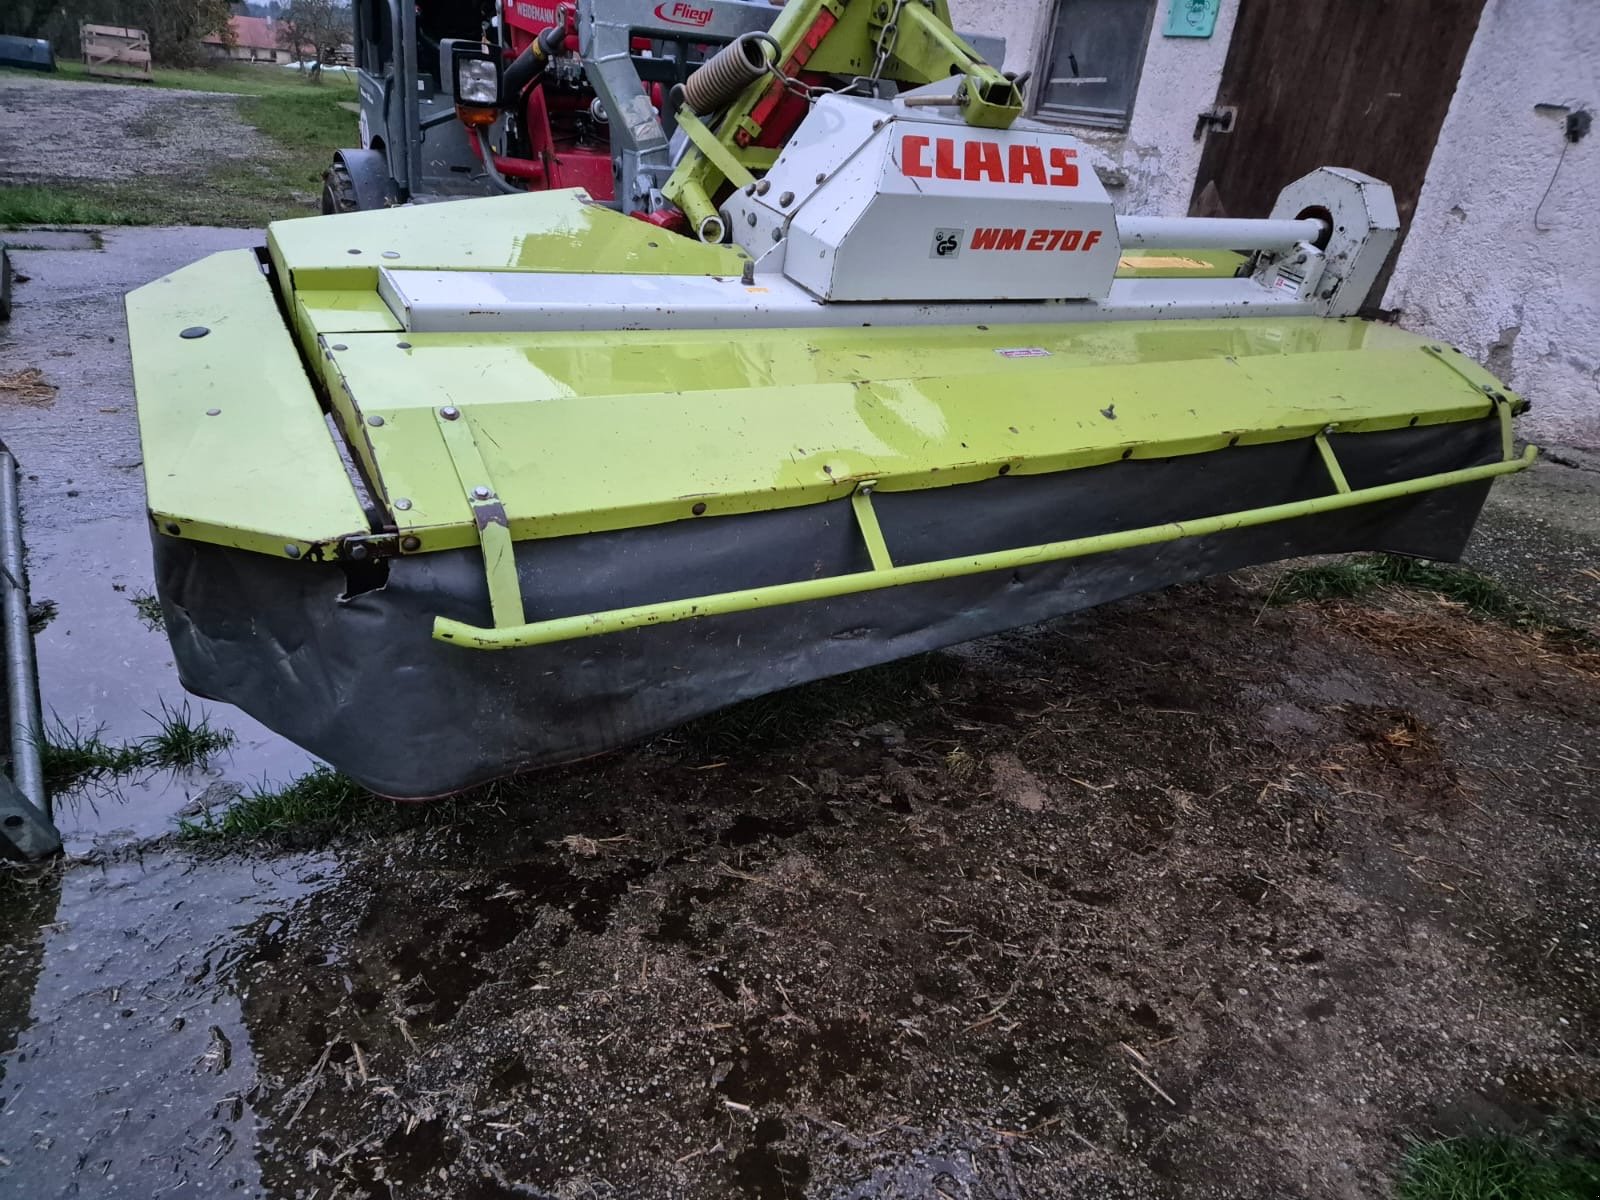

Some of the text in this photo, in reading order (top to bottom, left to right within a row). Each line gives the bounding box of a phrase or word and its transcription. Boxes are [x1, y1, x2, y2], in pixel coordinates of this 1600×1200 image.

[516, 2, 554, 24] WEIDEMANN
[672, 2, 714, 24] Fliegl
[902, 135, 1079, 187] CLAAS
[970, 228, 1102, 251] WM 270 F
